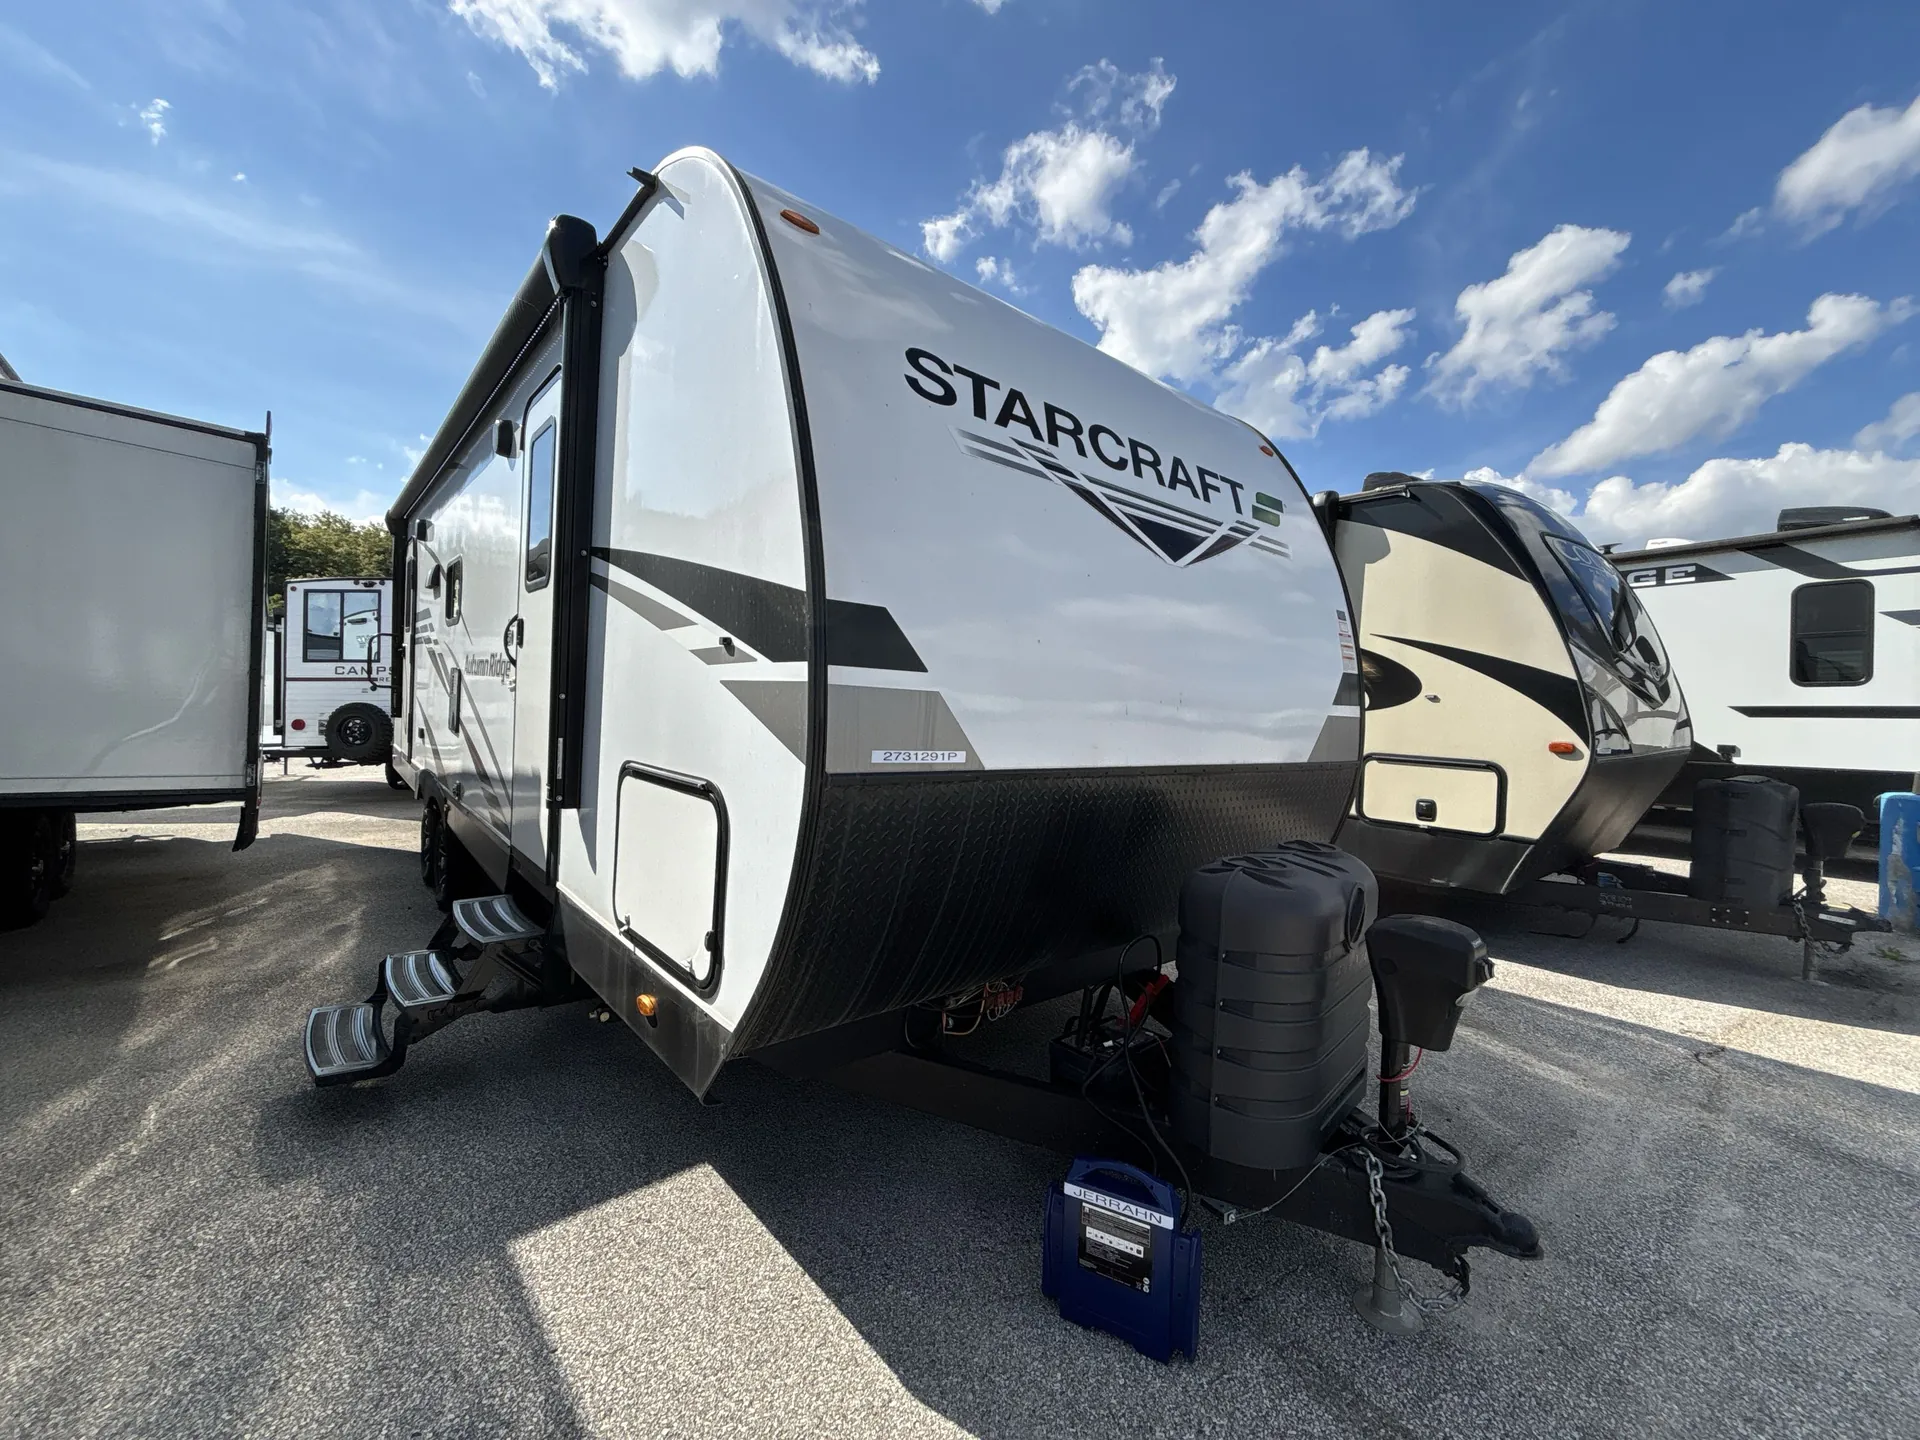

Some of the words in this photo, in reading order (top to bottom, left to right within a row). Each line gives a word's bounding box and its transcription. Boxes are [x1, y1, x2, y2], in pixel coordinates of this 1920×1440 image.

[904, 347, 1244, 515] STARCRAFT
[490, 652, 511, 685] Ridge
[883, 751, 958, 762] 2731291P
[1073, 1188, 1162, 1225] JERRAHN
